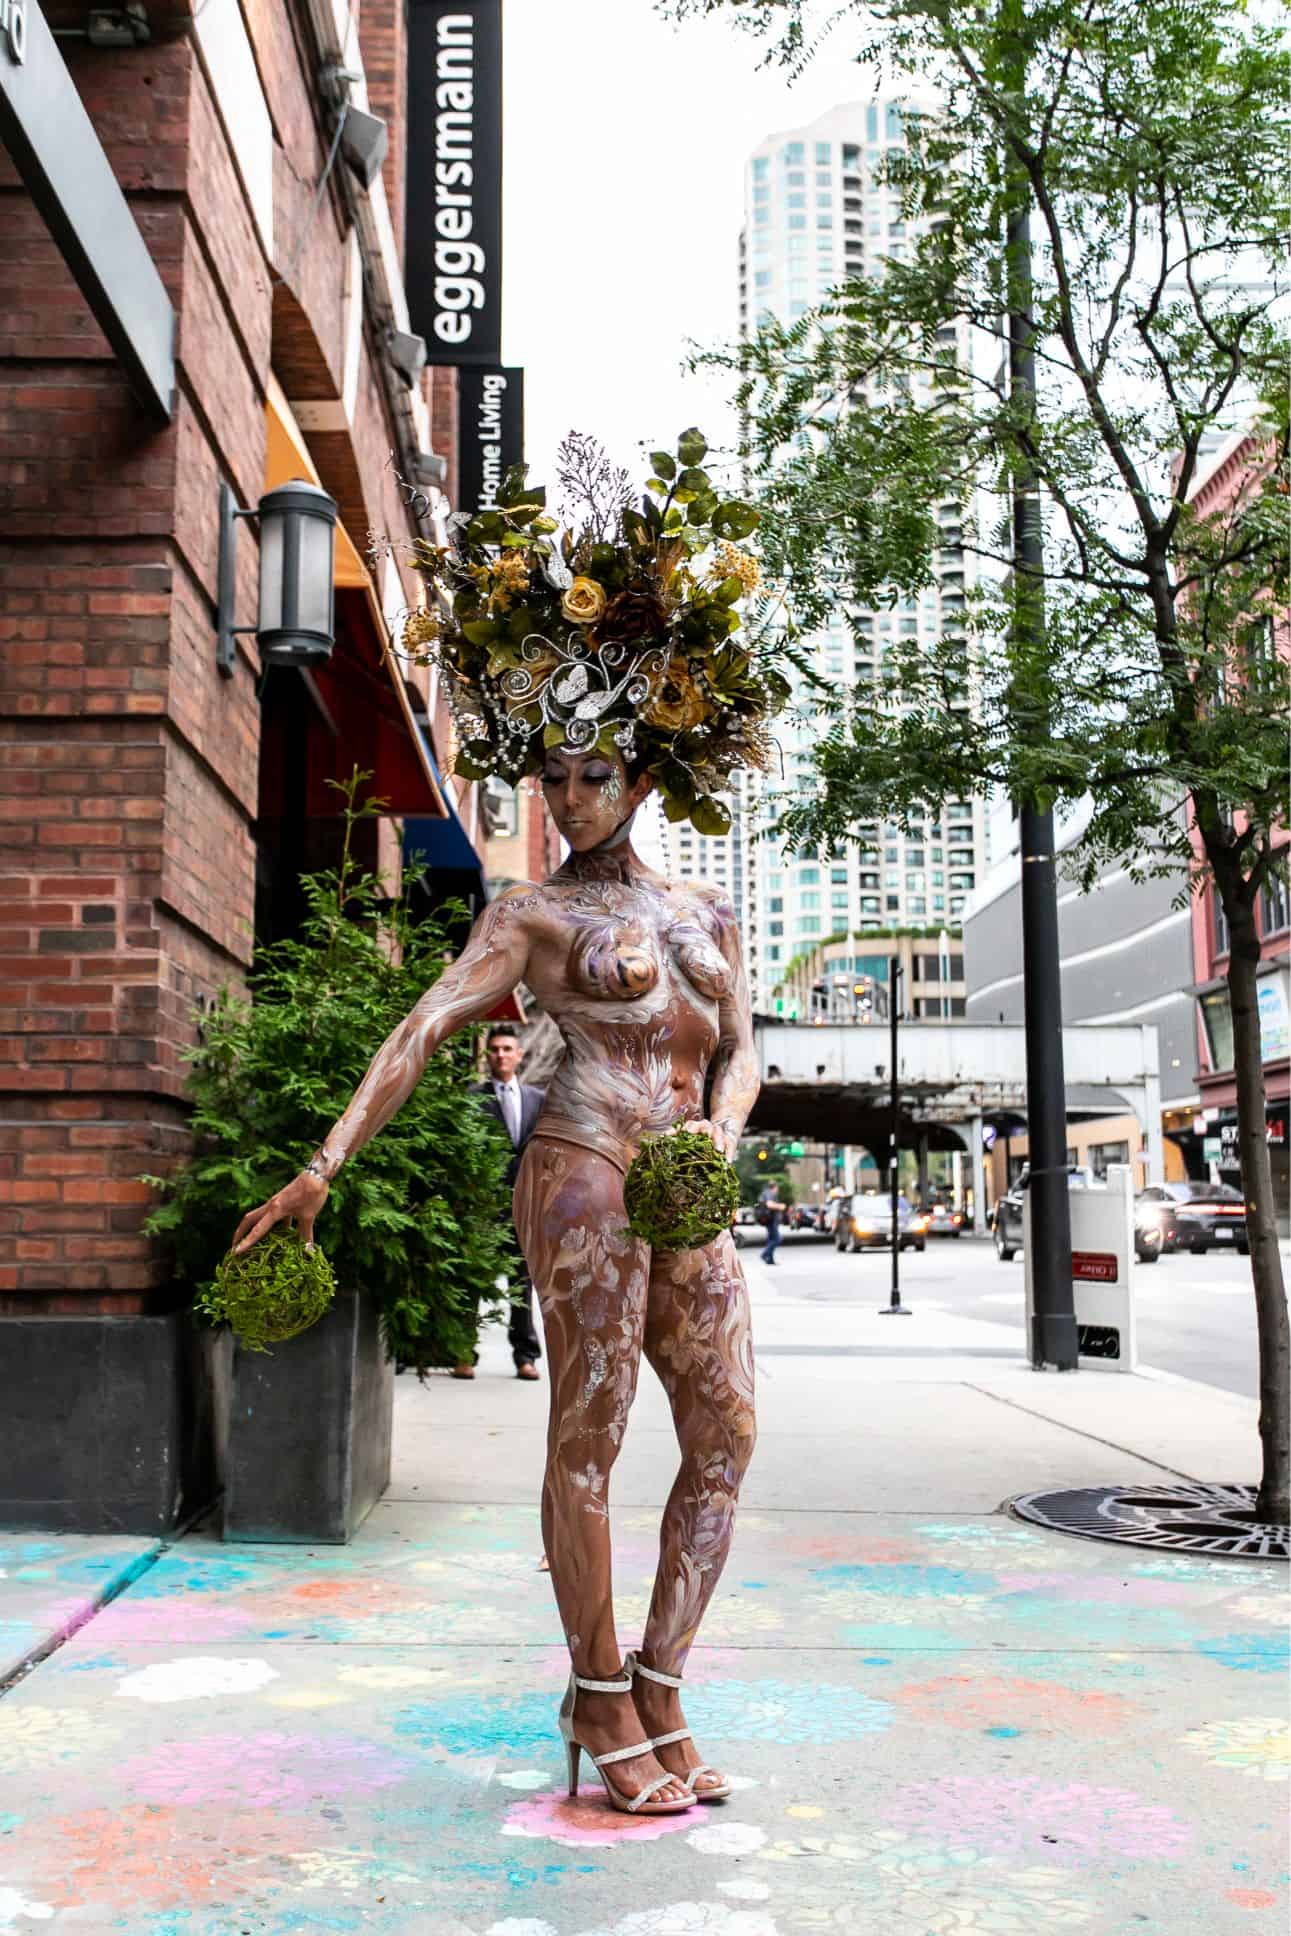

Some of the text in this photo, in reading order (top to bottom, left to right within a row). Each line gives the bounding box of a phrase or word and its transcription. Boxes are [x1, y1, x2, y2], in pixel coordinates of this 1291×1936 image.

[433, 12, 486, 345] eggersmann
[477, 374, 507, 441] Living
[477, 443, 501, 512] Home
